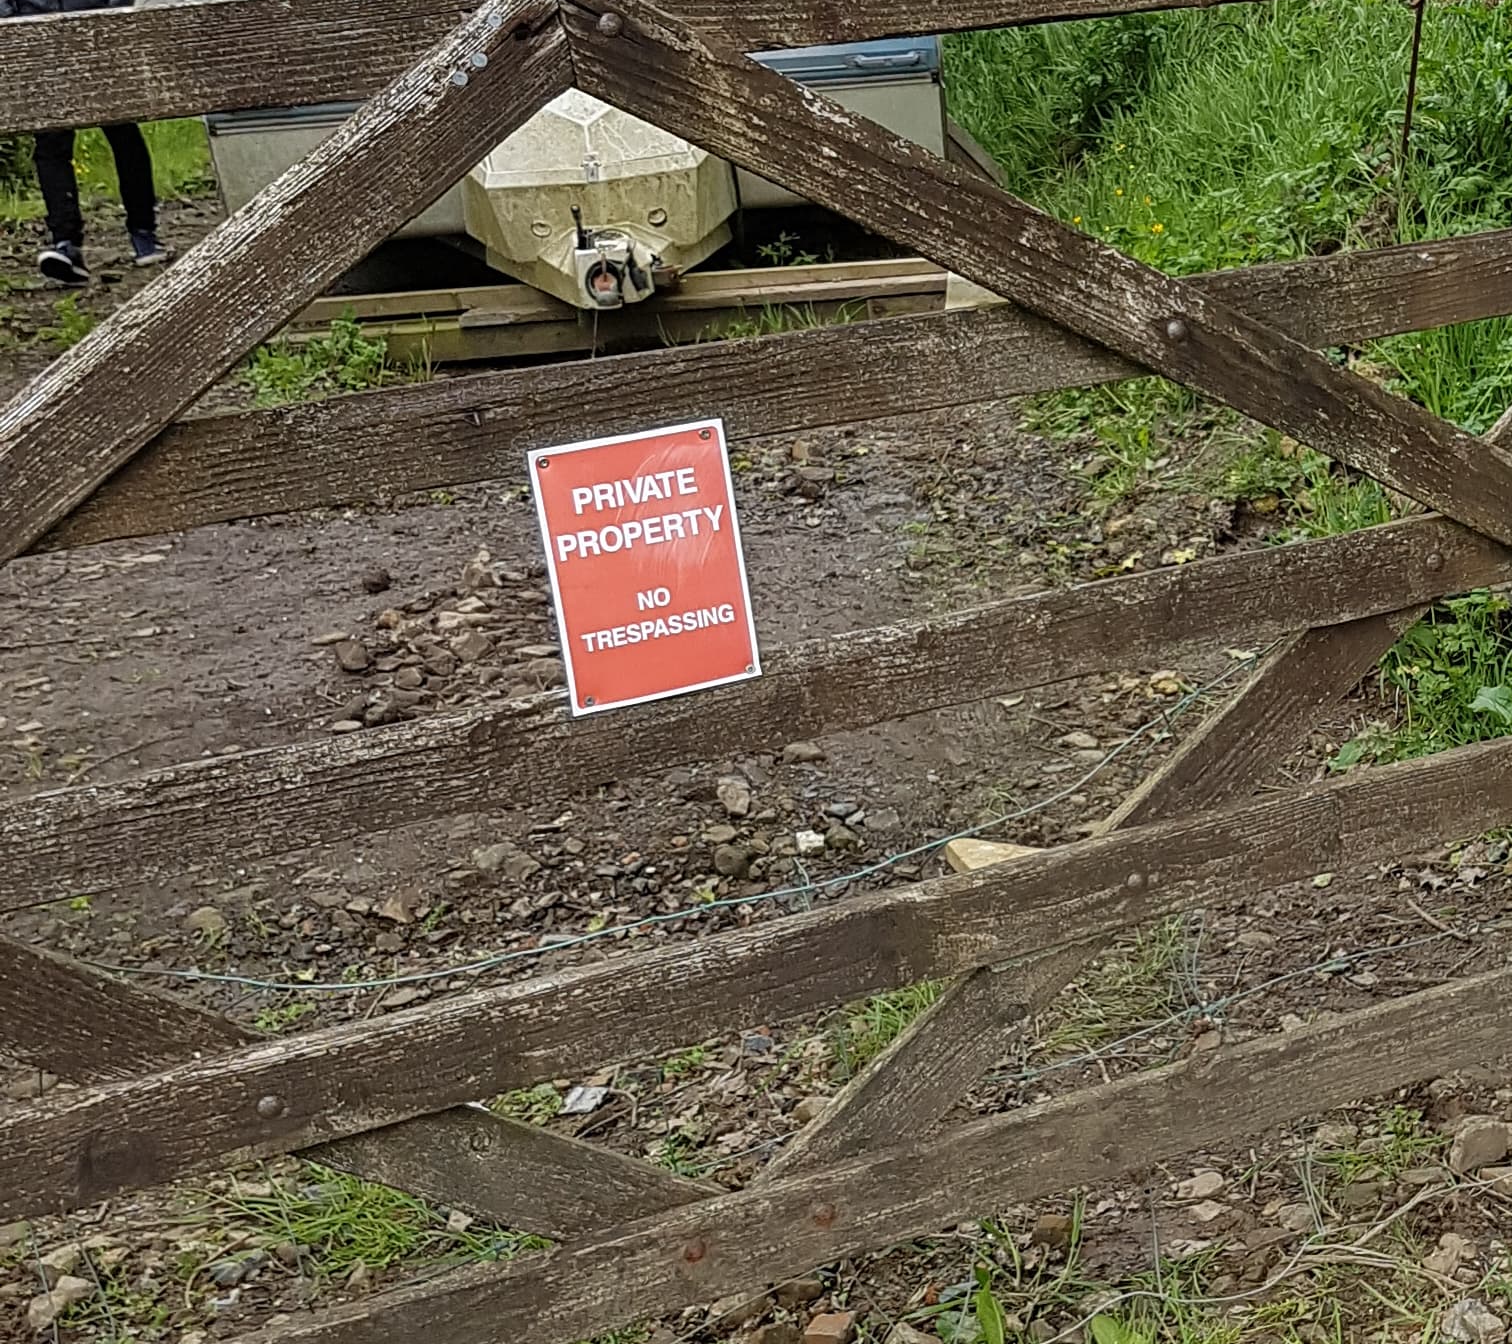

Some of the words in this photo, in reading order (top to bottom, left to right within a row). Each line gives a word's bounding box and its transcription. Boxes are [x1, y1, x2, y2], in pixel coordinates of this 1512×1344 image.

[572, 467, 698, 514] PRIVATE
[557, 504, 723, 561] PROPERTY
[636, 587, 670, 610] NO
[581, 604, 734, 652] TRESPASSING
